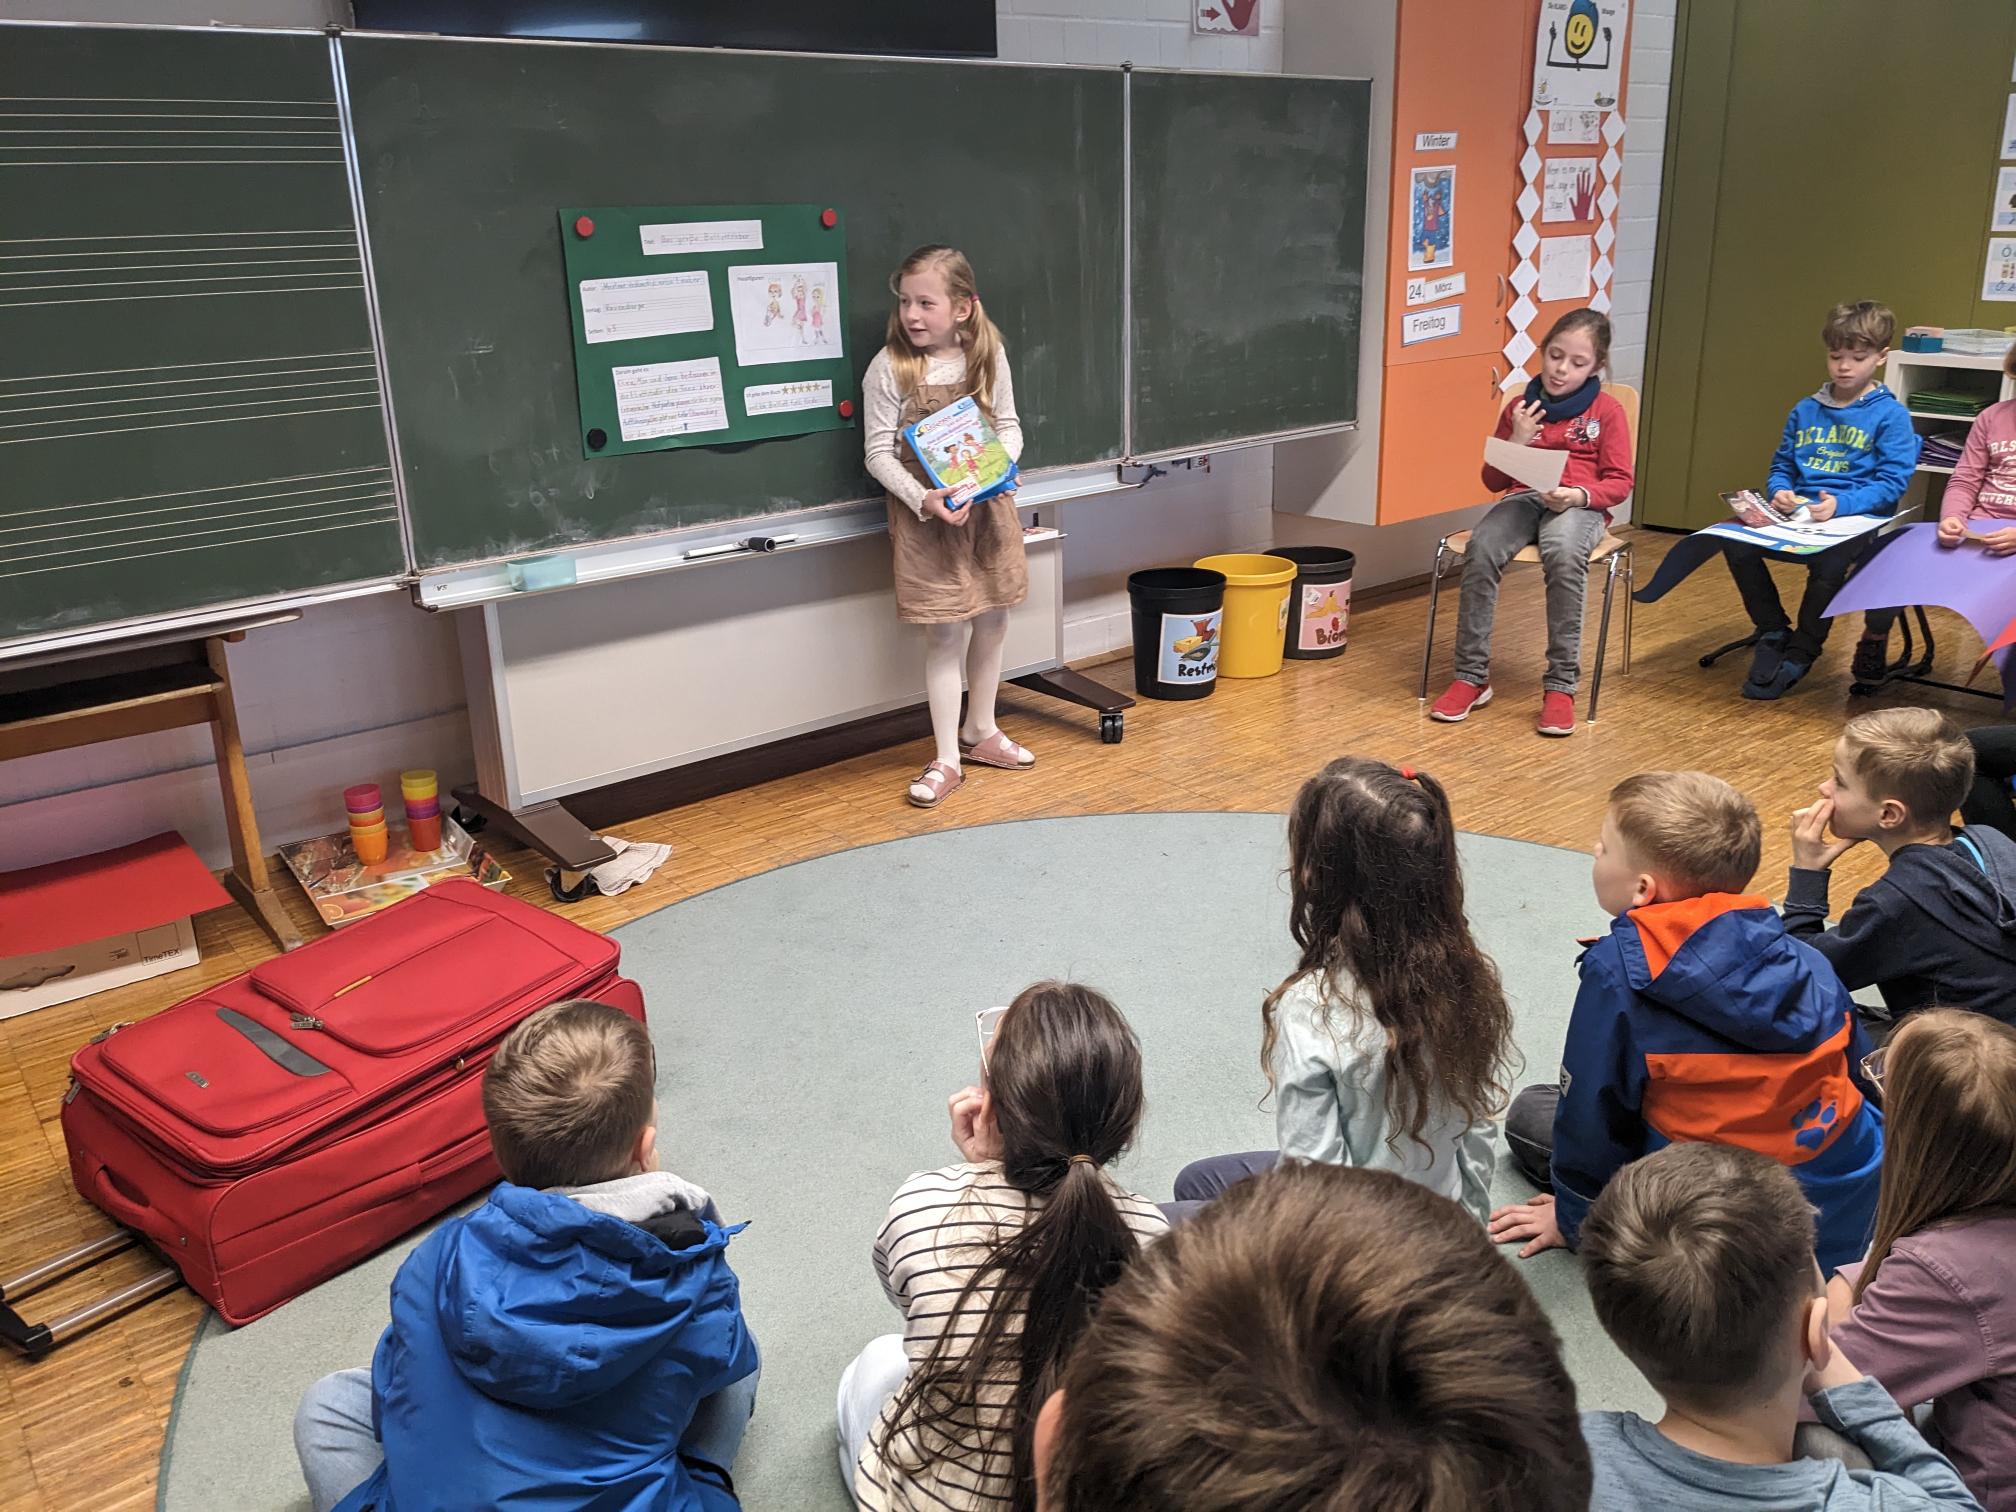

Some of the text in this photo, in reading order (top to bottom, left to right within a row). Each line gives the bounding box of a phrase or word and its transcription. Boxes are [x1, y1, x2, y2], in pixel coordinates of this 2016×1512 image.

[1422, 134, 1451, 147] Winter
[1412, 316, 1446, 332] Freitag
[1802, 456, 1849, 473] JEANS
[143, 948, 181, 963] TimeTEX
